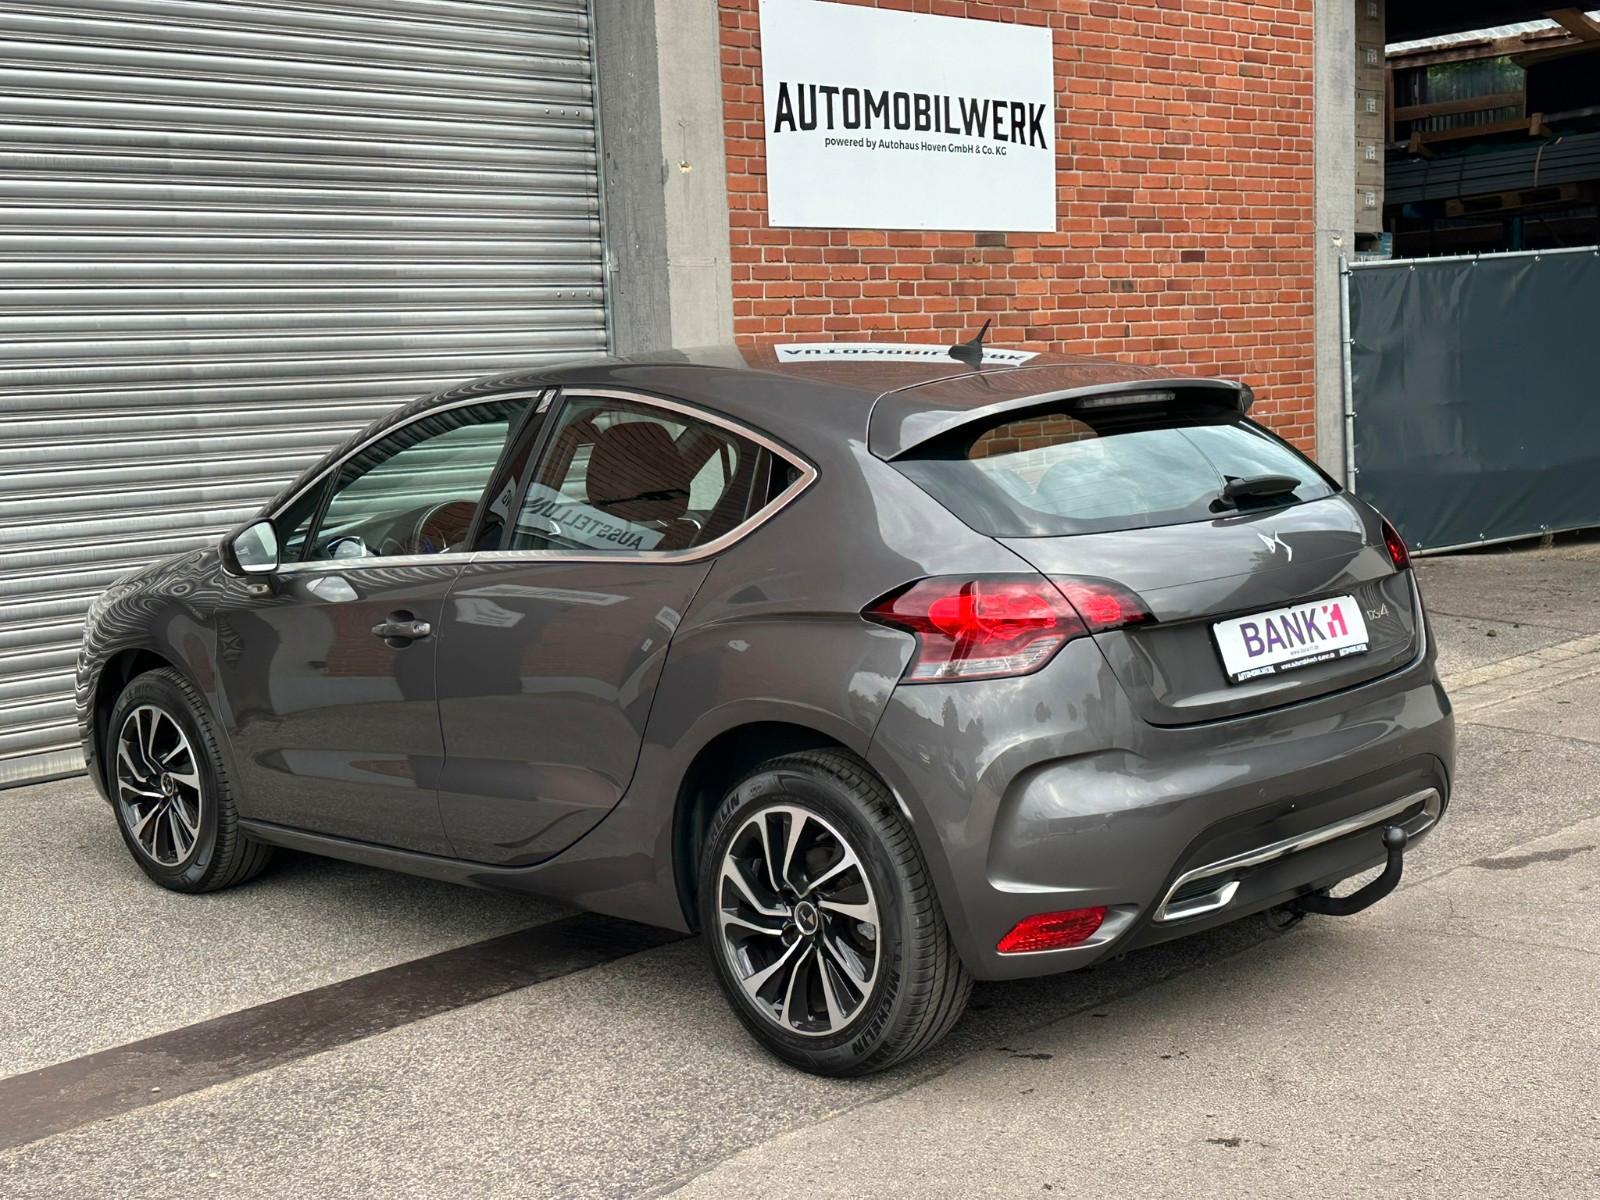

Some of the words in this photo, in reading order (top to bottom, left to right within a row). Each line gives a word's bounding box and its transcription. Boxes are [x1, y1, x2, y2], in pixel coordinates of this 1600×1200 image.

[773, 81, 1048, 150] AUTOMOBILWERK
[824, 137, 864, 148] powered
[866, 137, 877, 150] by
[878, 138, 920, 151] Autohaus
[920, 141, 947, 153] Hoven
[948, 143, 974, 154] GmbH
[975, 144, 981, 154] &
[982, 145, 995, 155] Co.
[995, 145, 1007, 156] KG
[851, 970, 901, 1057] MICHELIN
